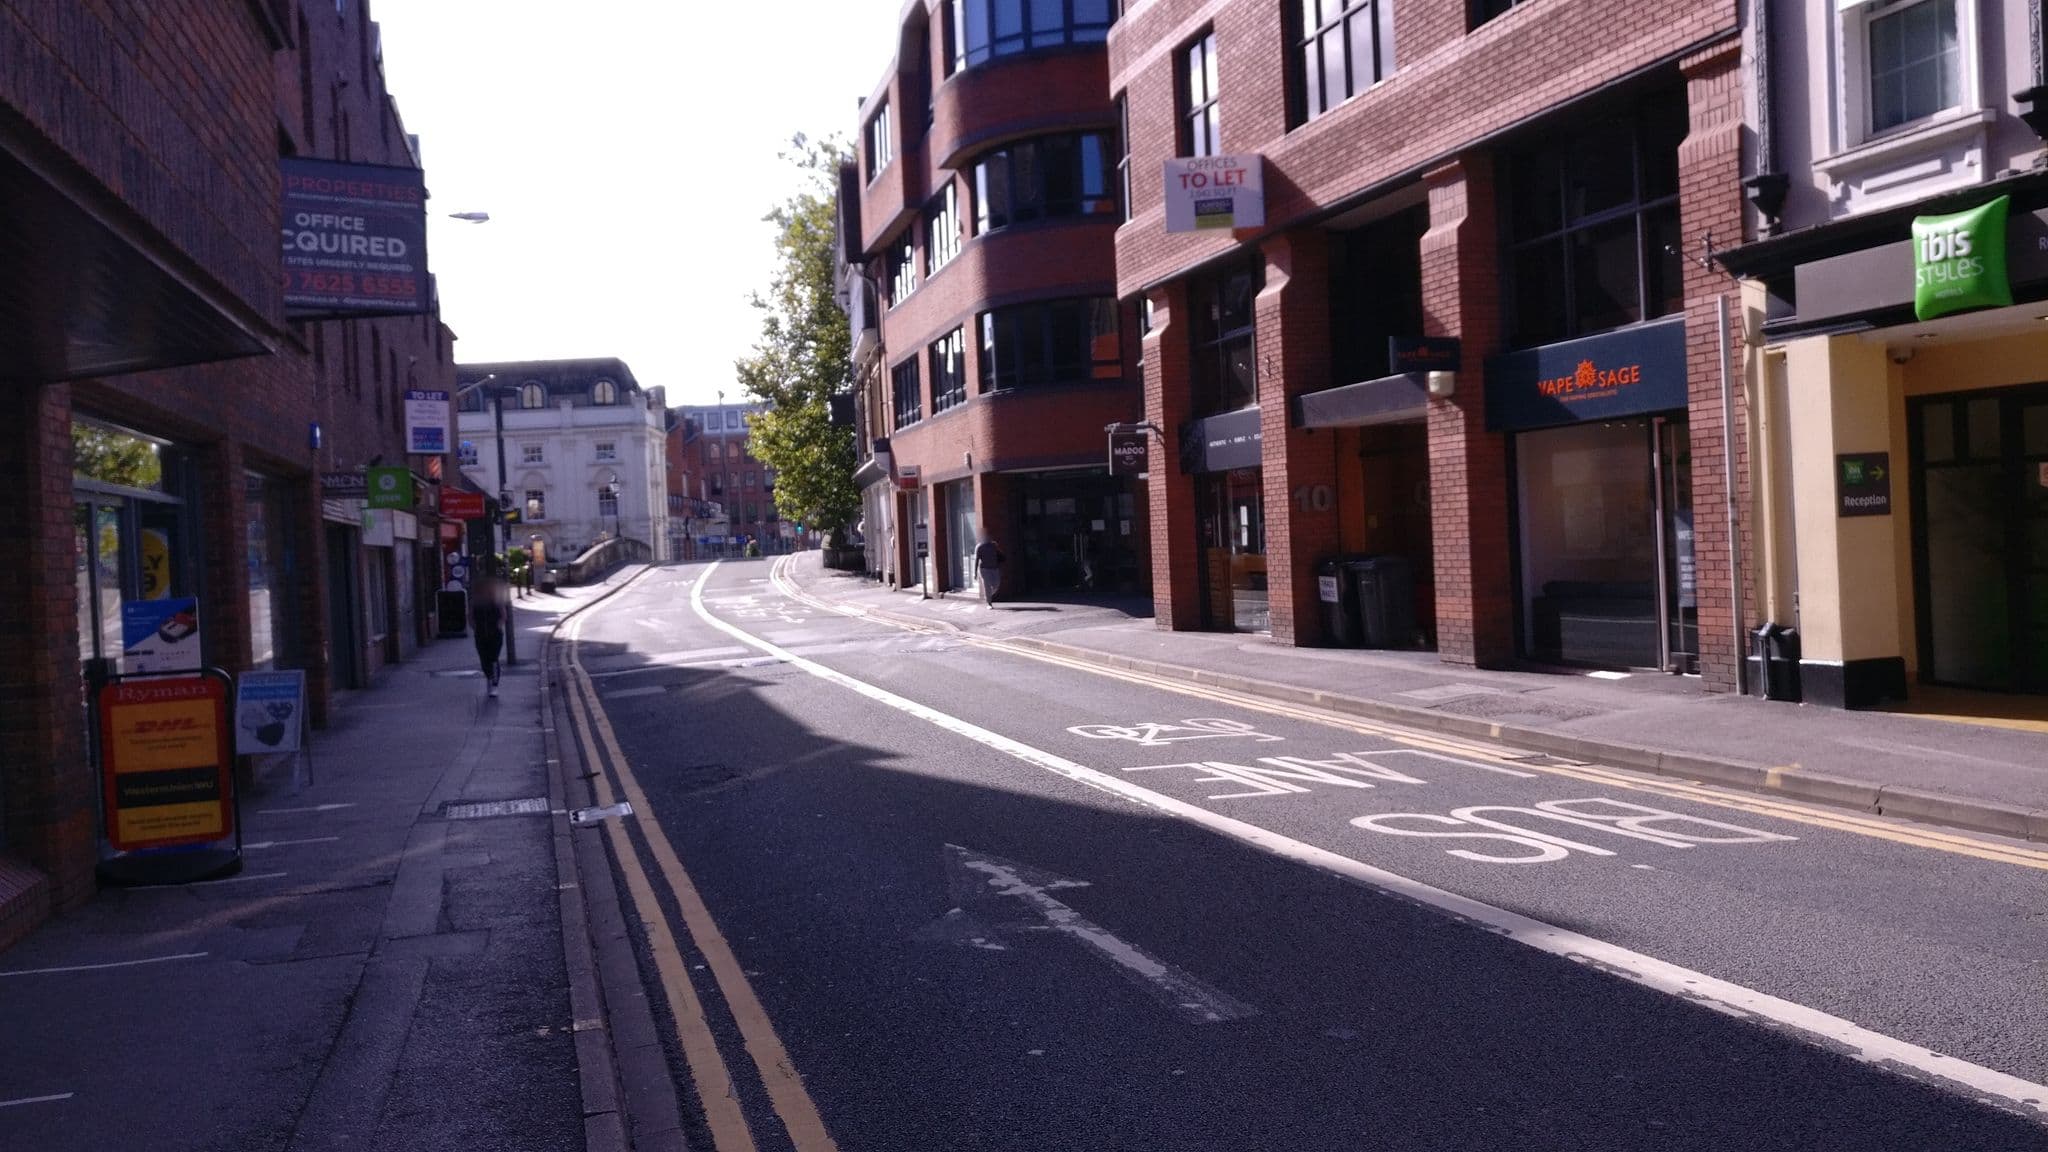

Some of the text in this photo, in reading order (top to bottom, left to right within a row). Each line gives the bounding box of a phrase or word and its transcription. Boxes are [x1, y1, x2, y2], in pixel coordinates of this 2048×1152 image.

[1187, 157, 1237, 171] OFFICES
[287, 175, 419, 201] PROPERTIES
[1179, 168, 1247, 189] TO LET
[295, 212, 366, 232] OFFICE
[1921, 230, 1973, 264] ibis
[288, 256, 314, 266] SITES
[316, 258, 365, 270] URGENTLY
[366, 261, 414, 273] REQUIRED
[300, 272, 355, 291] 7625
[362, 275, 418, 296] 6555
[1536, 364, 1642, 397] VAPE SAGE
[410, 391, 444, 401] TO LET
[1293, 484, 1332, 511] 10
[1843, 494, 1888, 507] Reception
[117, 685, 209, 703] Ryman
[1123, 747, 1537, 799] LANE
[1350, 797, 1799, 866] BUS
